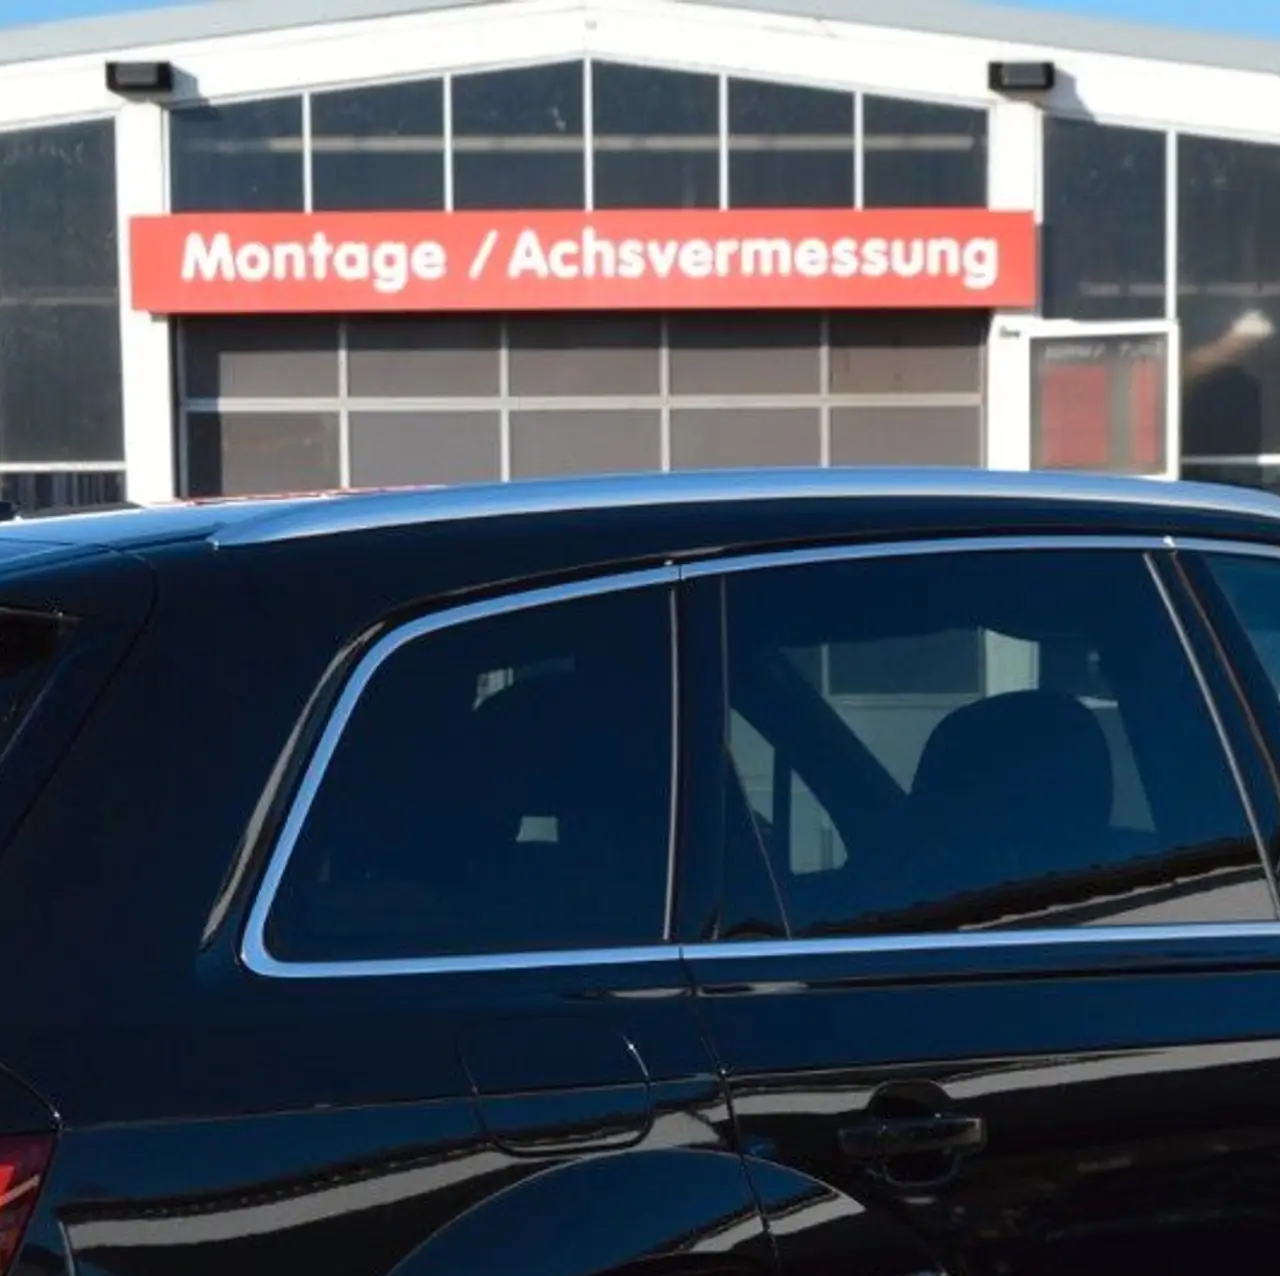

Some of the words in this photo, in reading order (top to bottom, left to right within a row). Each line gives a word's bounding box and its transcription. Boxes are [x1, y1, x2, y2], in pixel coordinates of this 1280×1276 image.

[180, 231, 449, 293] Montage
[468, 229, 499, 281] /
[506, 226, 999, 291] Achsvermessung
